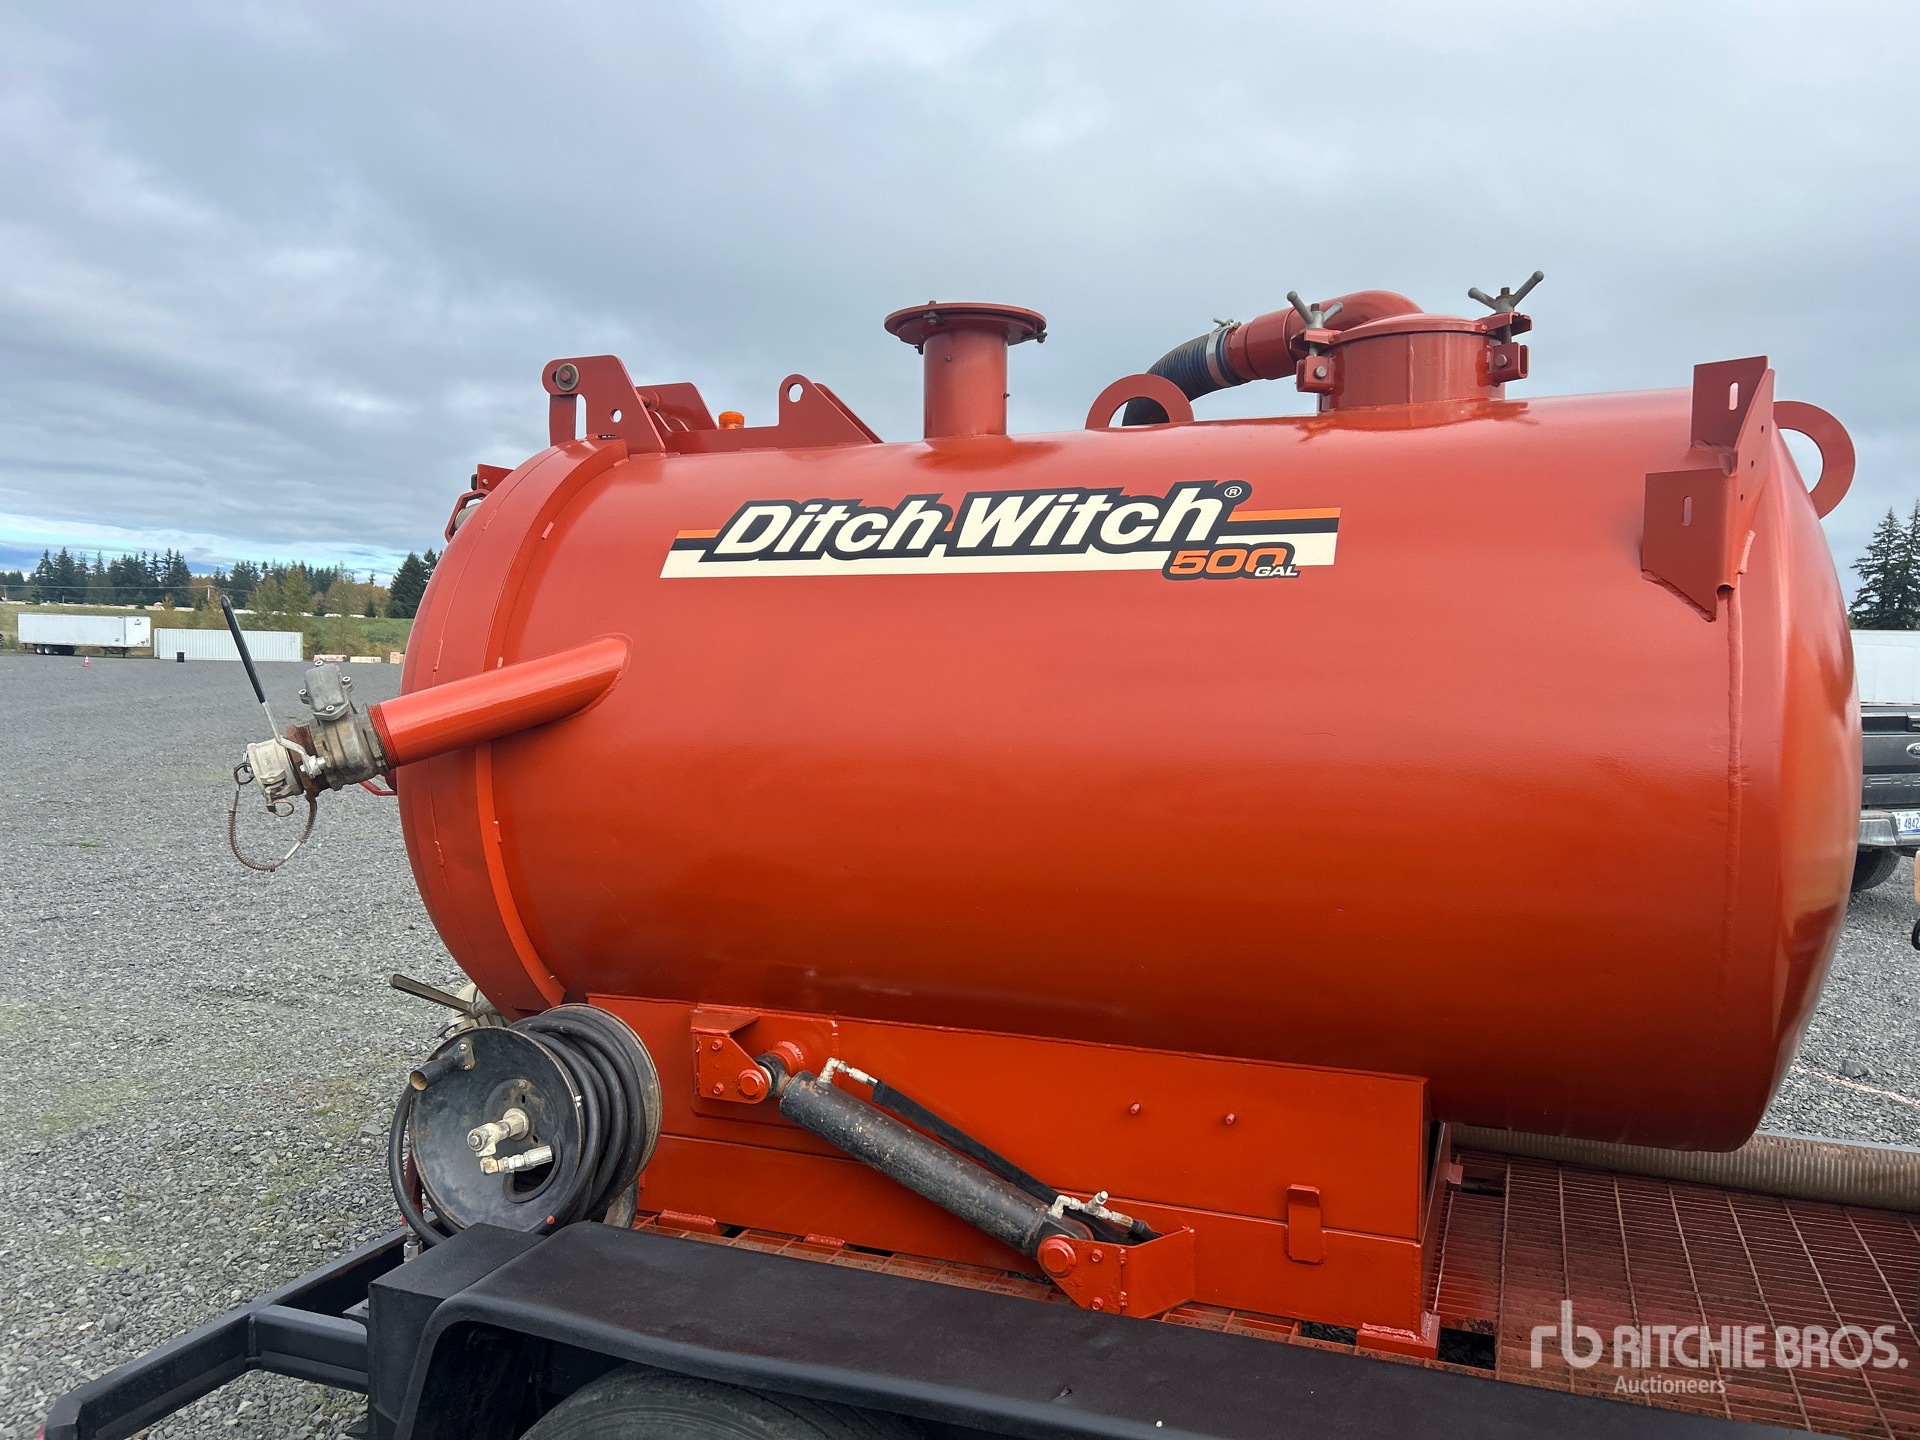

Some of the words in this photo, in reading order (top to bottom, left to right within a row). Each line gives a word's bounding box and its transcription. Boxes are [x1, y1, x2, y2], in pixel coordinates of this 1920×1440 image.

[713, 499, 943, 554] Ditch
[1169, 547, 1288, 575] 500
[1254, 565, 1298, 577] GAL
